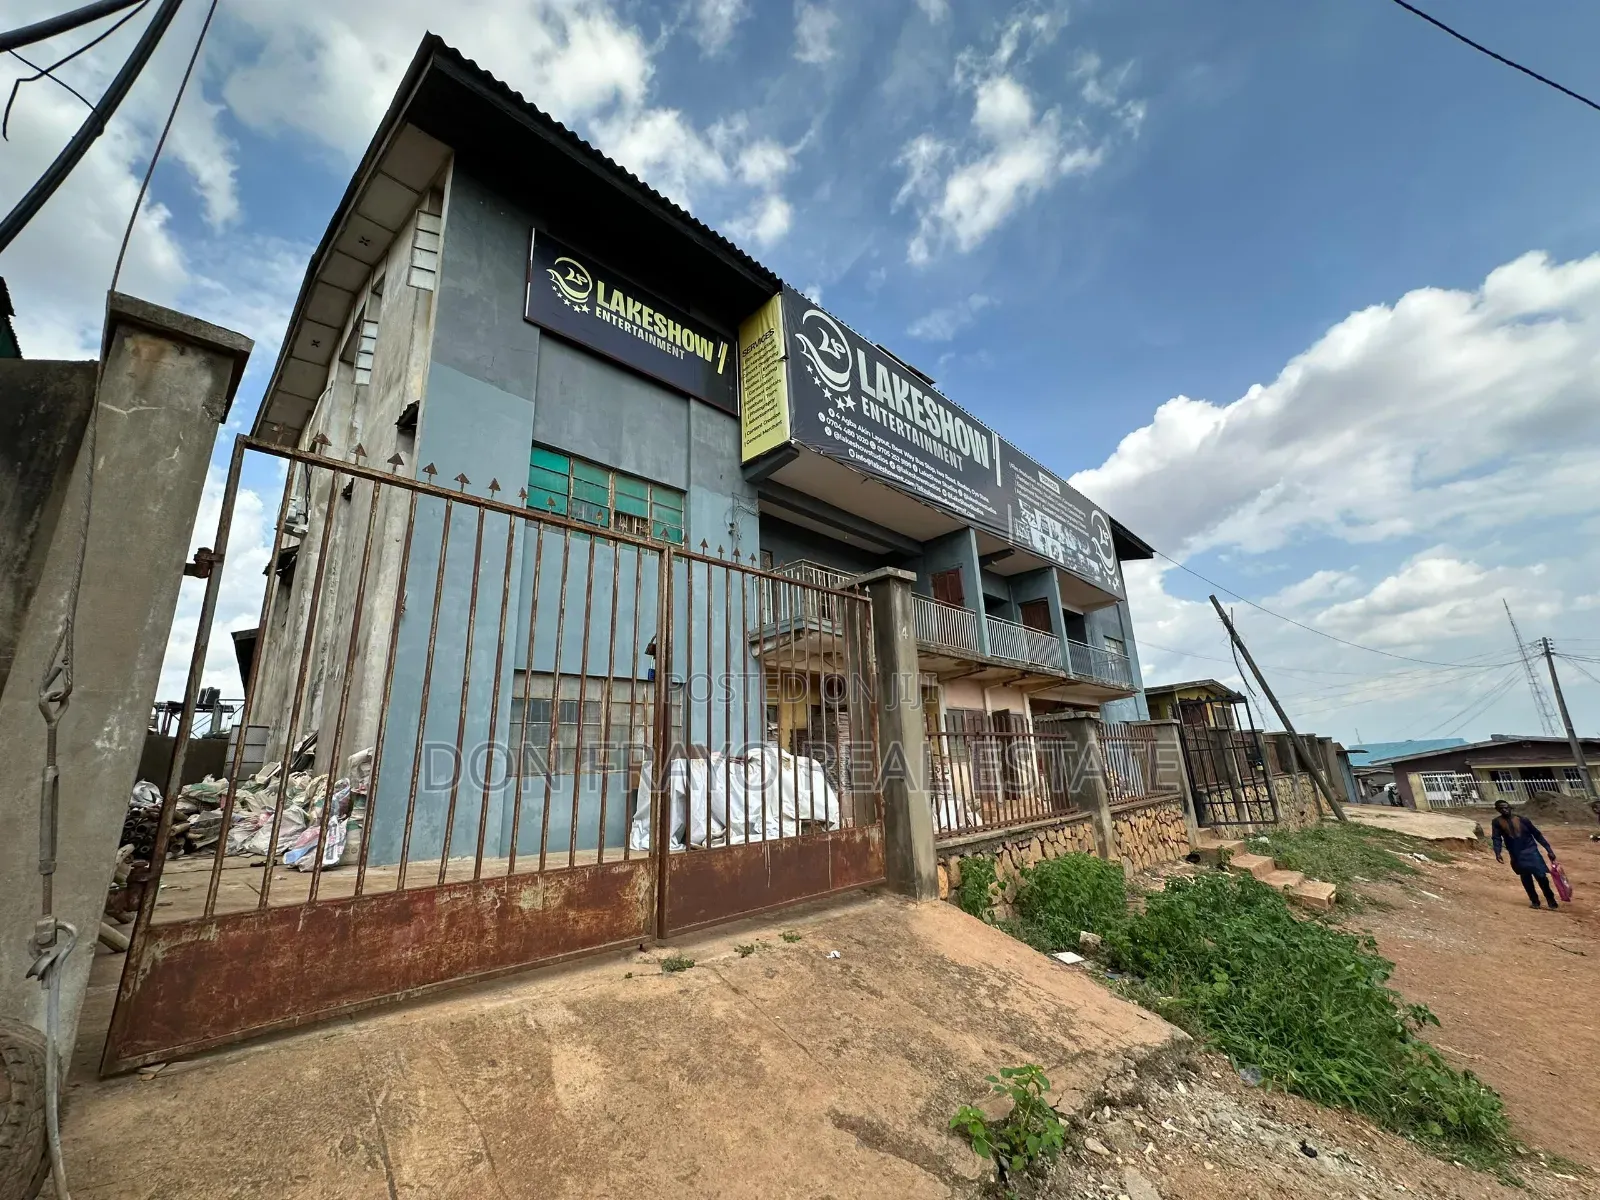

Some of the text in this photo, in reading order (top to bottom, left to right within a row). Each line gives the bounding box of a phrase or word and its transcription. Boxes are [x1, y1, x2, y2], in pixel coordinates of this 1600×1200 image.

[595, 305, 685, 360] ENTERTAINMENT
[597, 280, 714, 363] LAKESHOW
[742, 328, 775, 357] SERVICES
[836, 412, 841, 420] 4
[841, 415, 857, 429] Agba
[857, 424, 871, 437] Akin
[856, 347, 990, 470] LAKESHOW
[826, 417, 843, 431] 0704
[843, 427, 855, 438] 480
[855, 433, 869, 446] 1020
[861, 395, 963, 472] ENTERTAINMENT
[902, 625, 909, 640] 4
